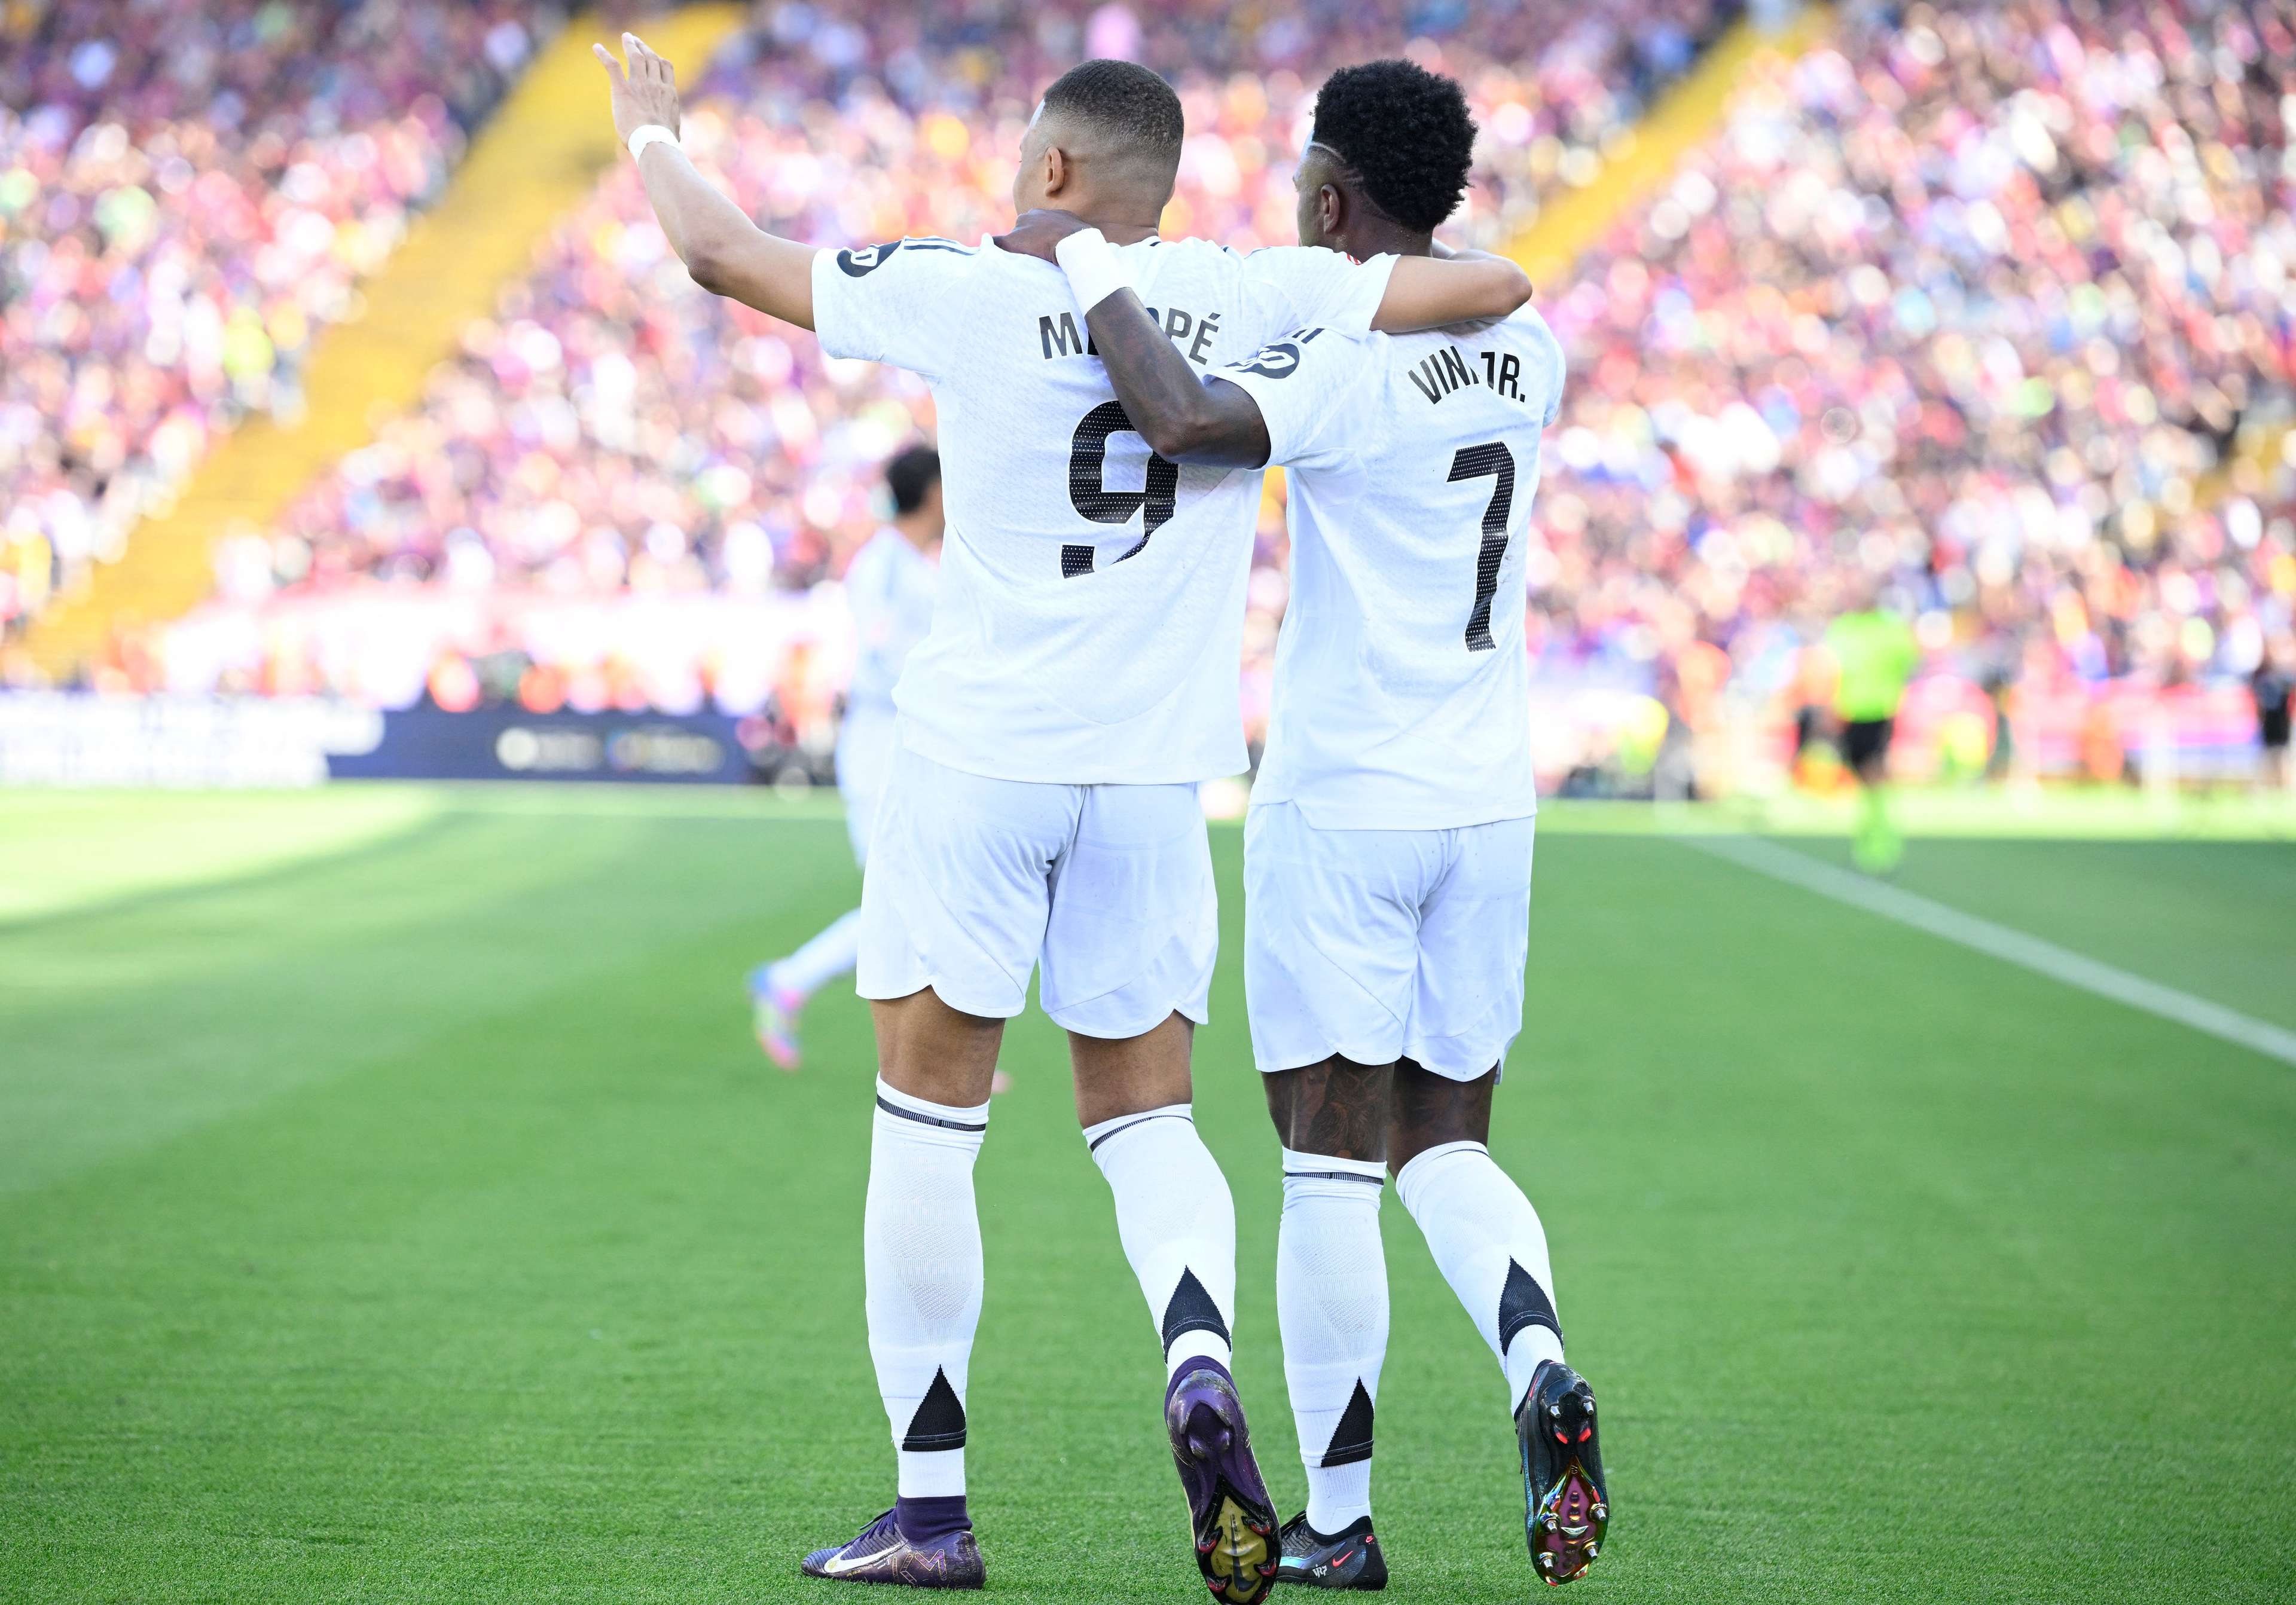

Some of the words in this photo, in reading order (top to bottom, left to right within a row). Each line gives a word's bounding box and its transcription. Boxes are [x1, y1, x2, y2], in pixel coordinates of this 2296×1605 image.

[1039, 307, 1221, 365] MPÉ
[1061, 400, 1178, 579] 9
[1446, 441, 1515, 652] 7
